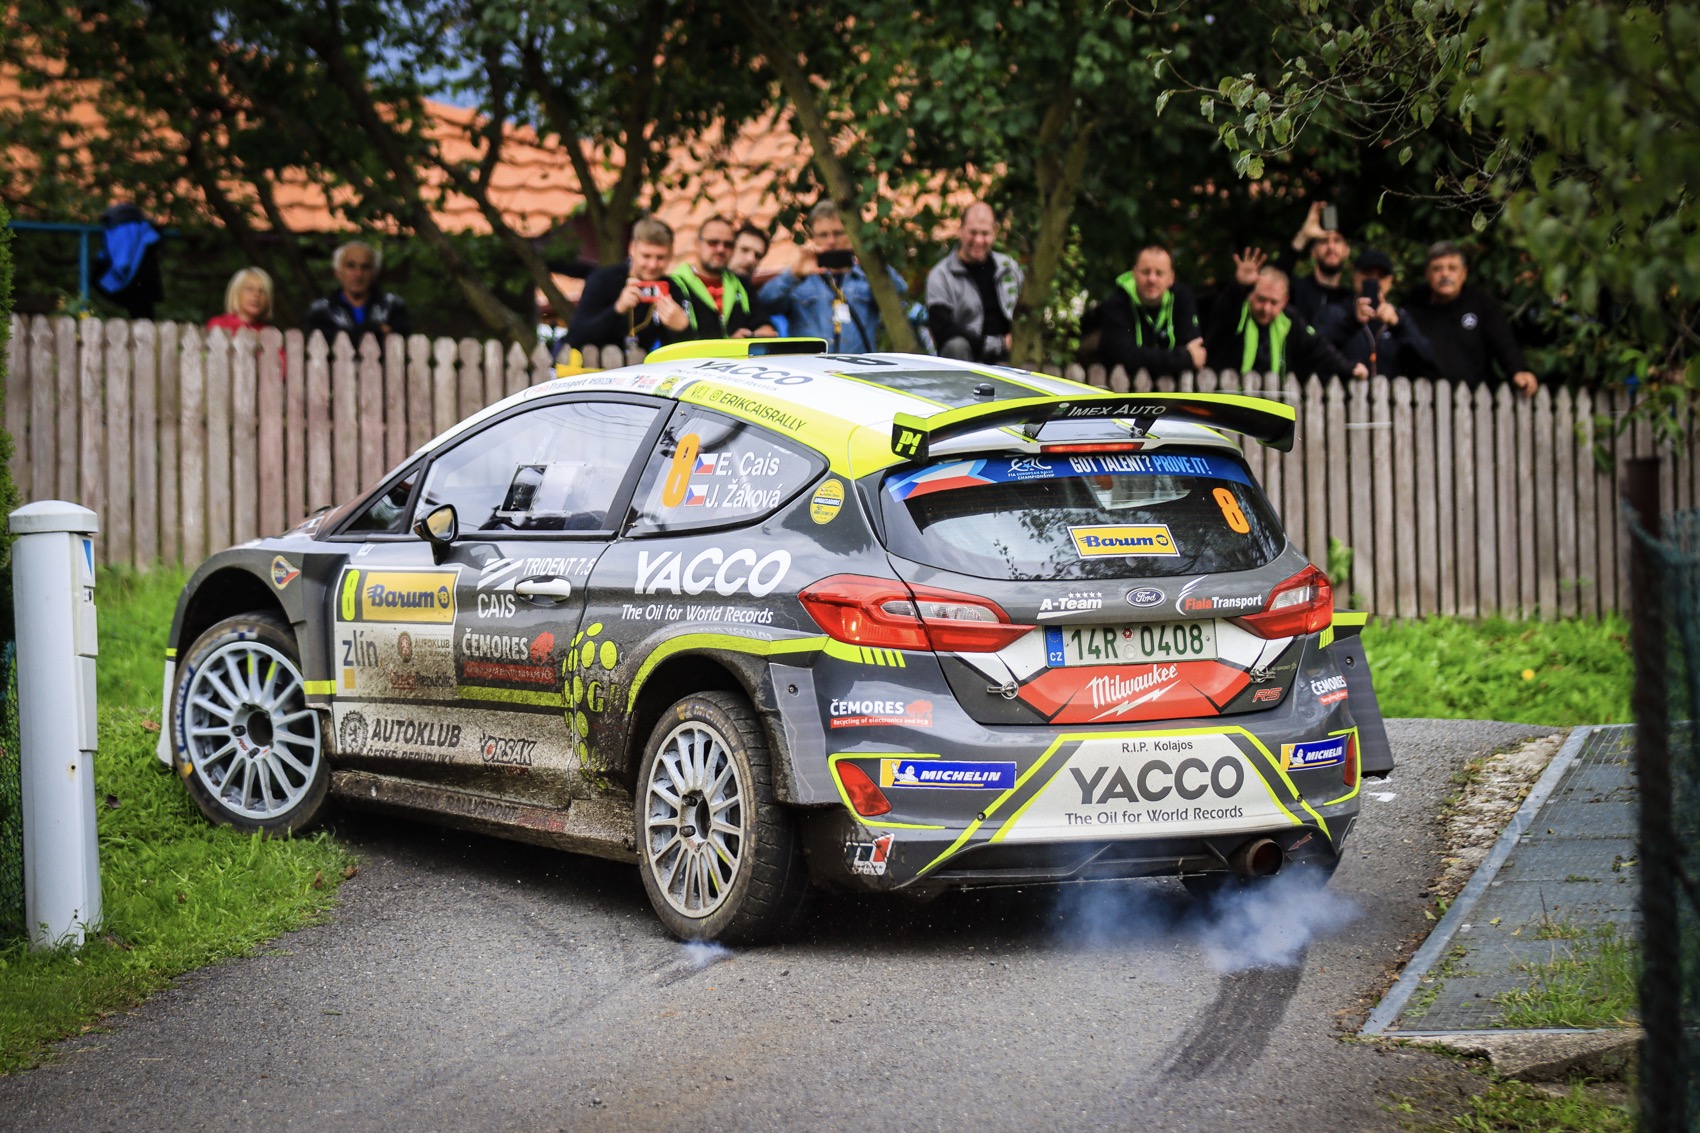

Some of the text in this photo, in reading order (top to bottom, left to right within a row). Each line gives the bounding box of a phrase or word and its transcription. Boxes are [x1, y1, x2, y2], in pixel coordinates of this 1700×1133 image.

[694, 361, 813, 385] YACCO
[662, 433, 700, 508] 8
[715, 451, 780, 476] E. Cais
[1068, 456, 1095, 473] GOT
[1150, 456, 1191, 474] PROVE
[1189, 457, 1213, 475] IT!
[705, 478, 782, 508] J. Žáková
[1212, 487, 1251, 534] 8
[1079, 535, 1154, 548] Barum
[523, 557, 597, 576] TRIDENT 7.5
[634, 547, 792, 597] YACCO
[341, 569, 360, 621] 8
[367, 584, 435, 608] Barum
[477, 593, 516, 619] CAIS
[1039, 597, 1103, 610] A-Team
[1135, 591, 1157, 603] Ford
[621, 603, 774, 624] The Oil for World Records
[342, 629, 379, 668] zlín
[462, 628, 530, 660] ČEMORES
[1071, 623, 1204, 660] 14R 0408
[1049, 651, 1064, 662] CZ
[1085, 664, 1178, 710] Milwaukee
[1252, 687, 1283, 703] RS
[830, 699, 904, 716] ČEMORES
[370, 718, 462, 748] AUTOKLUB
[833, 718, 861, 726] Recycling
[869, 716, 903, 724] electronics
[1122, 740, 1194, 753] R.I.P. Kolajos
[1304, 745, 1343, 762] MICHELIN
[919, 770, 1001, 782] MICHELIN
[1069, 755, 1245, 805] YACCO
[1065, 805, 1244, 825] The Oil for World Records
